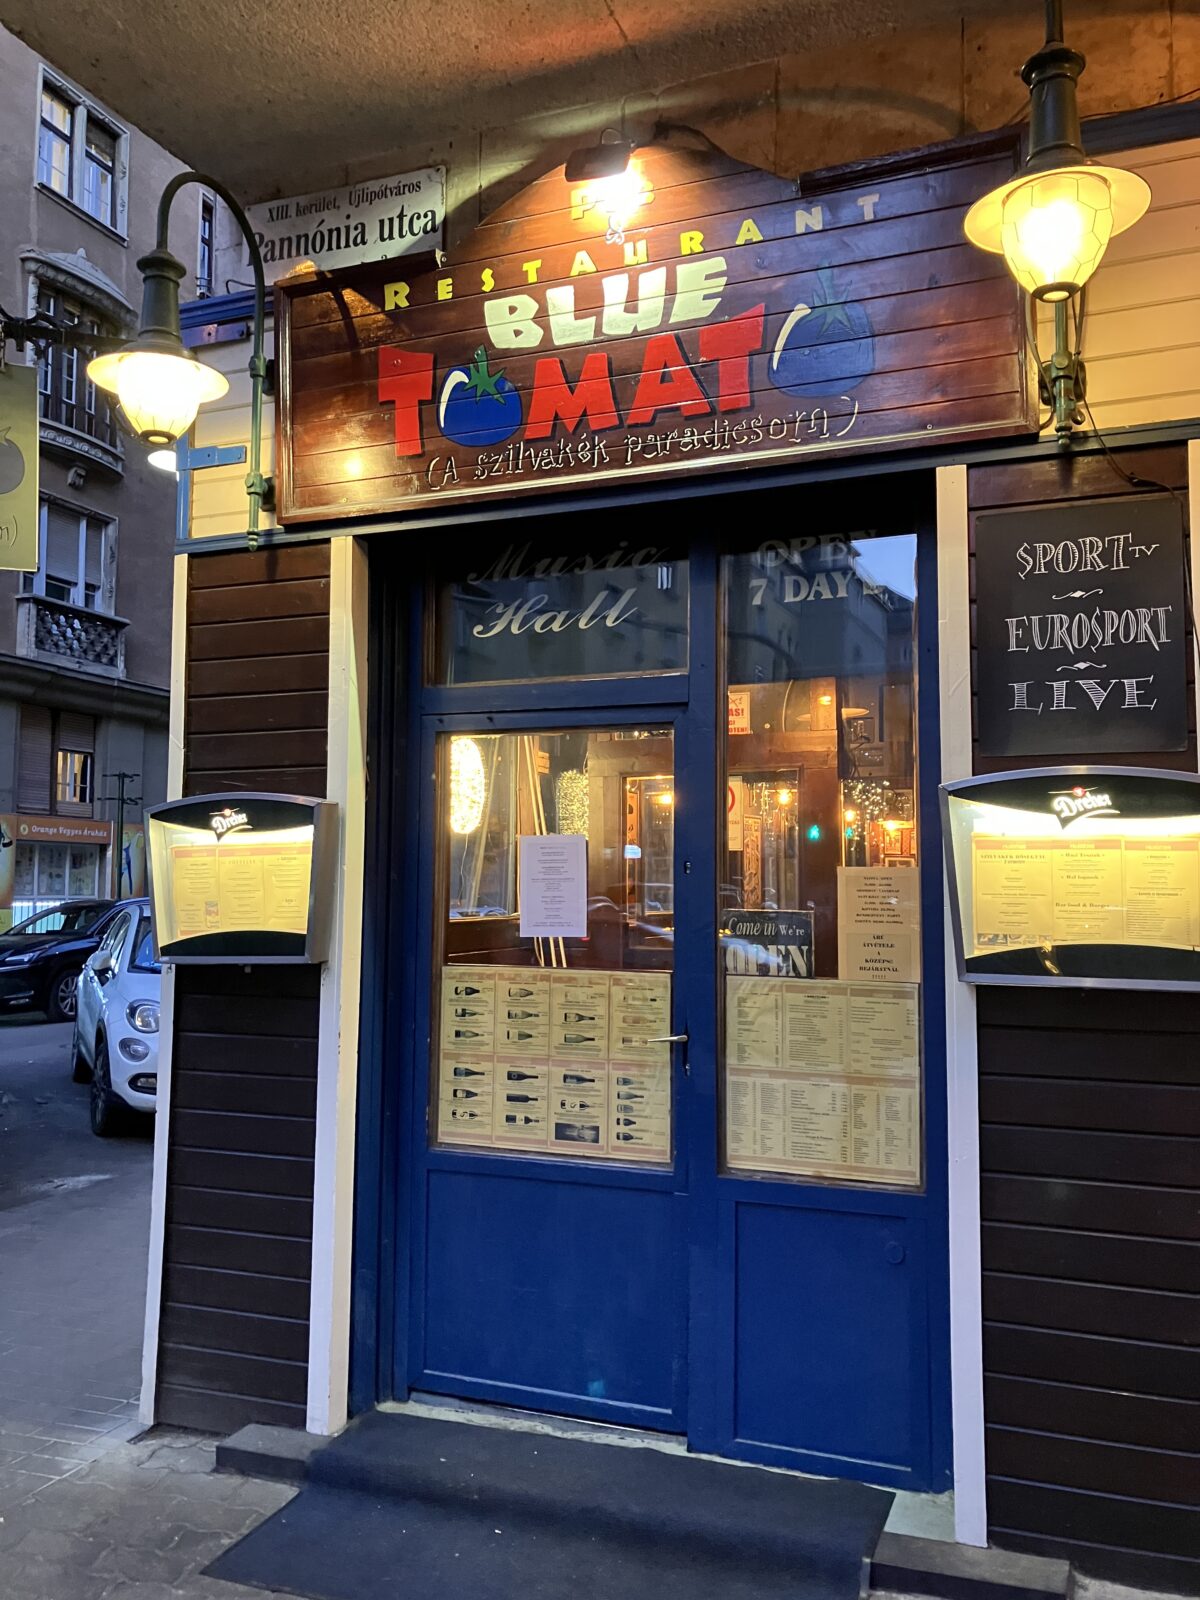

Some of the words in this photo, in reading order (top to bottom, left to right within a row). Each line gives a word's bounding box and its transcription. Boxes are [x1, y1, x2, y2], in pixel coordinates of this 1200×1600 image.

[267, 206, 292, 223] XIII.
[378, 204, 440, 243] utca
[383, 193, 881, 312] RESTAURANT
[483, 256, 728, 350] BLUE
[466, 540, 670, 585] Music
[1016, 532, 1133, 580] SPORT
[750, 578, 768, 605] 7
[472, 588, 638, 638] Hall
[1004, 605, 1173, 655] EUROSPORT
[1007, 675, 1158, 715] LIVE
[1053, 791, 1113, 818] Dreher
[727, 917, 761, 936] Come
[763, 922, 777, 936] in
[778, 924, 805, 936] We're
[725, 944, 809, 977] OPEN
